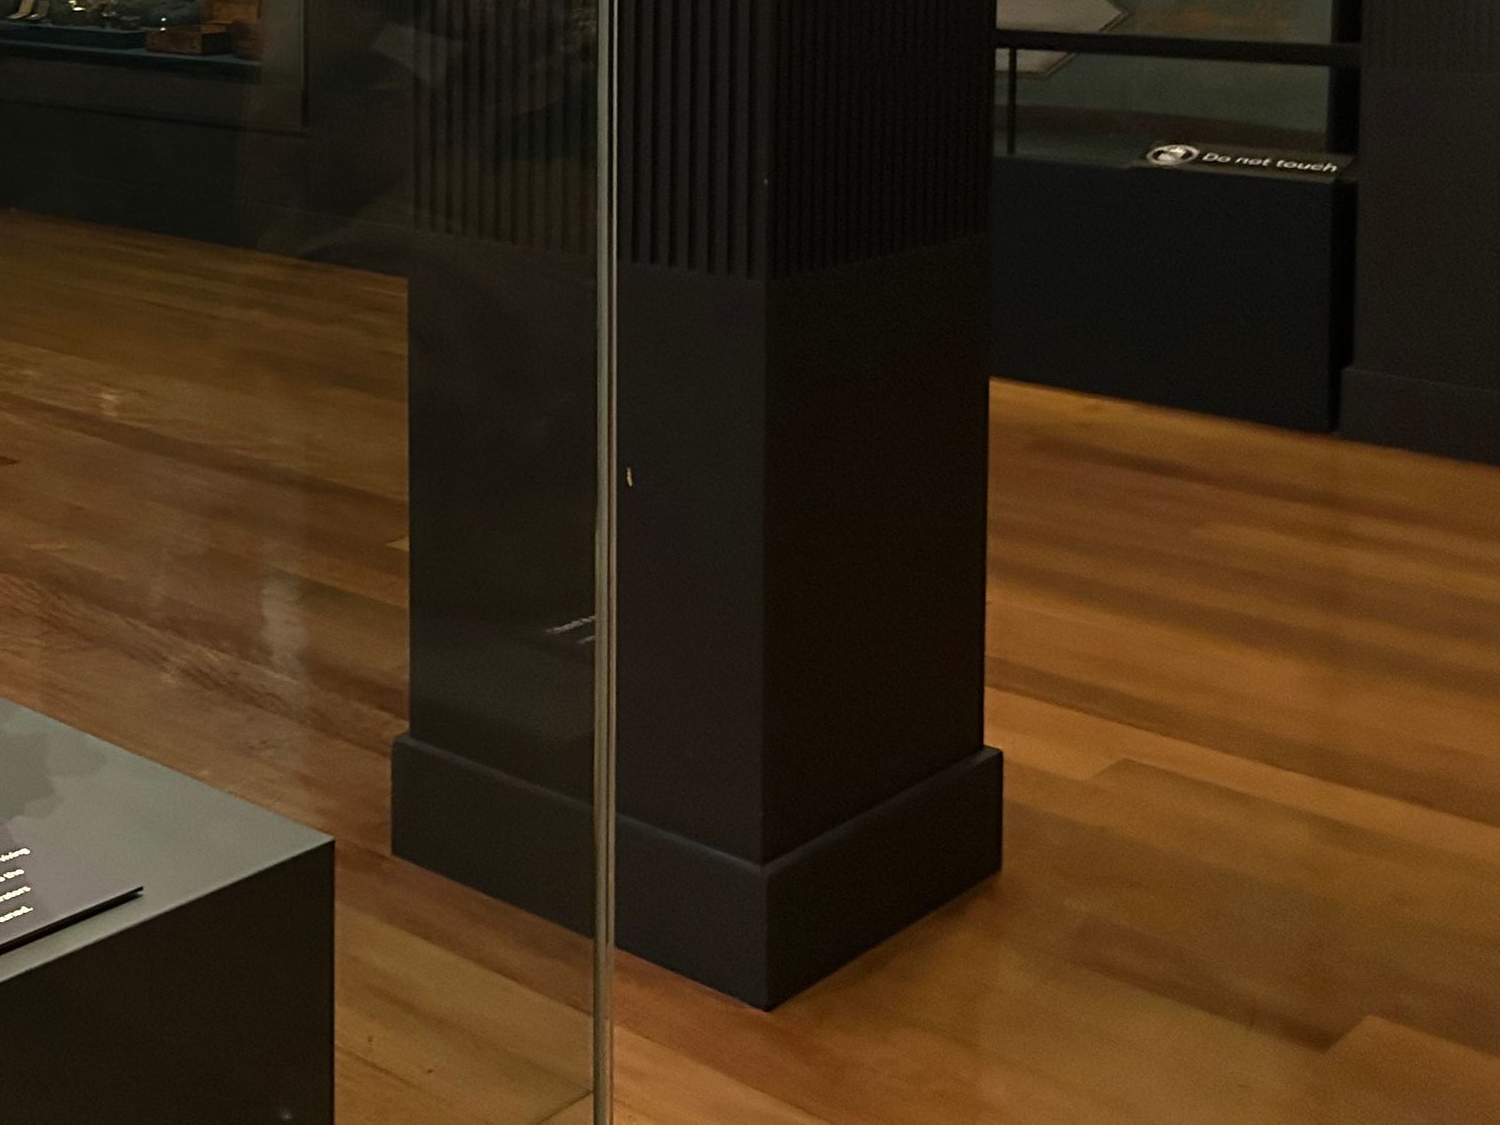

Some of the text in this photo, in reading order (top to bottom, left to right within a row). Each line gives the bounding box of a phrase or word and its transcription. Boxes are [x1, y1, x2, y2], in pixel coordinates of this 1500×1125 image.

[1202, 152, 1338, 172] Do not touch
[2, 868, 24, 879] the
